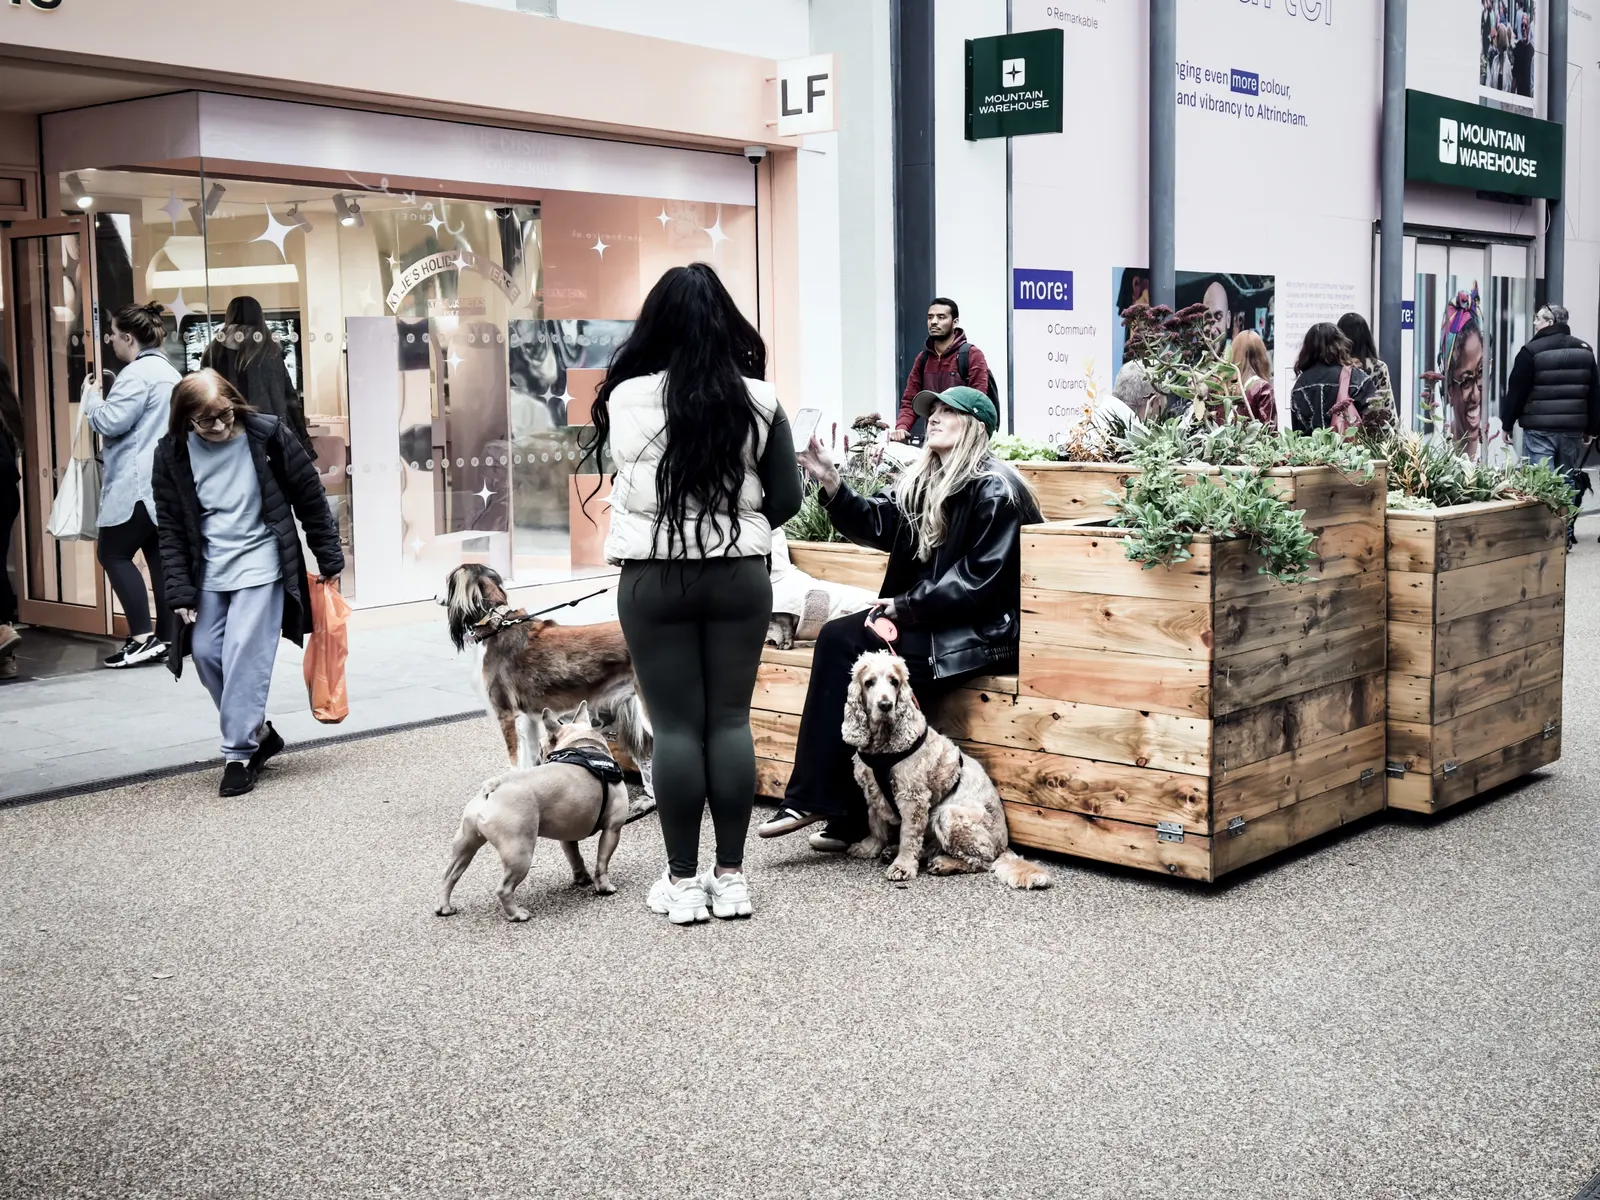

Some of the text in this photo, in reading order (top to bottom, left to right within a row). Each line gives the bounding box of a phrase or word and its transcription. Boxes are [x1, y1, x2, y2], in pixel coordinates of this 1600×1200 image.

[1053, 7, 1098, 29] Remarkable
[781, 73, 829, 116] LF
[1204, 68, 1229, 85] even
[1232, 73, 1257, 91] more
[1260, 79, 1291, 100] colour,
[979, 100, 1049, 114] WAREHOUSE
[984, 90, 1043, 104] MOUNTAIN
[1177, 91, 1308, 127] and vibrancy to Altrincham.
[1460, 122, 1525, 153] MOUNTAIN
[1459, 146, 1537, 178] WAREHOUSE
[1020, 280, 1068, 300] more:
[1054, 323, 1097, 337] Community
[1054, 351, 1069, 364] Joy
[1054, 378, 1087, 390] Vibrancy
